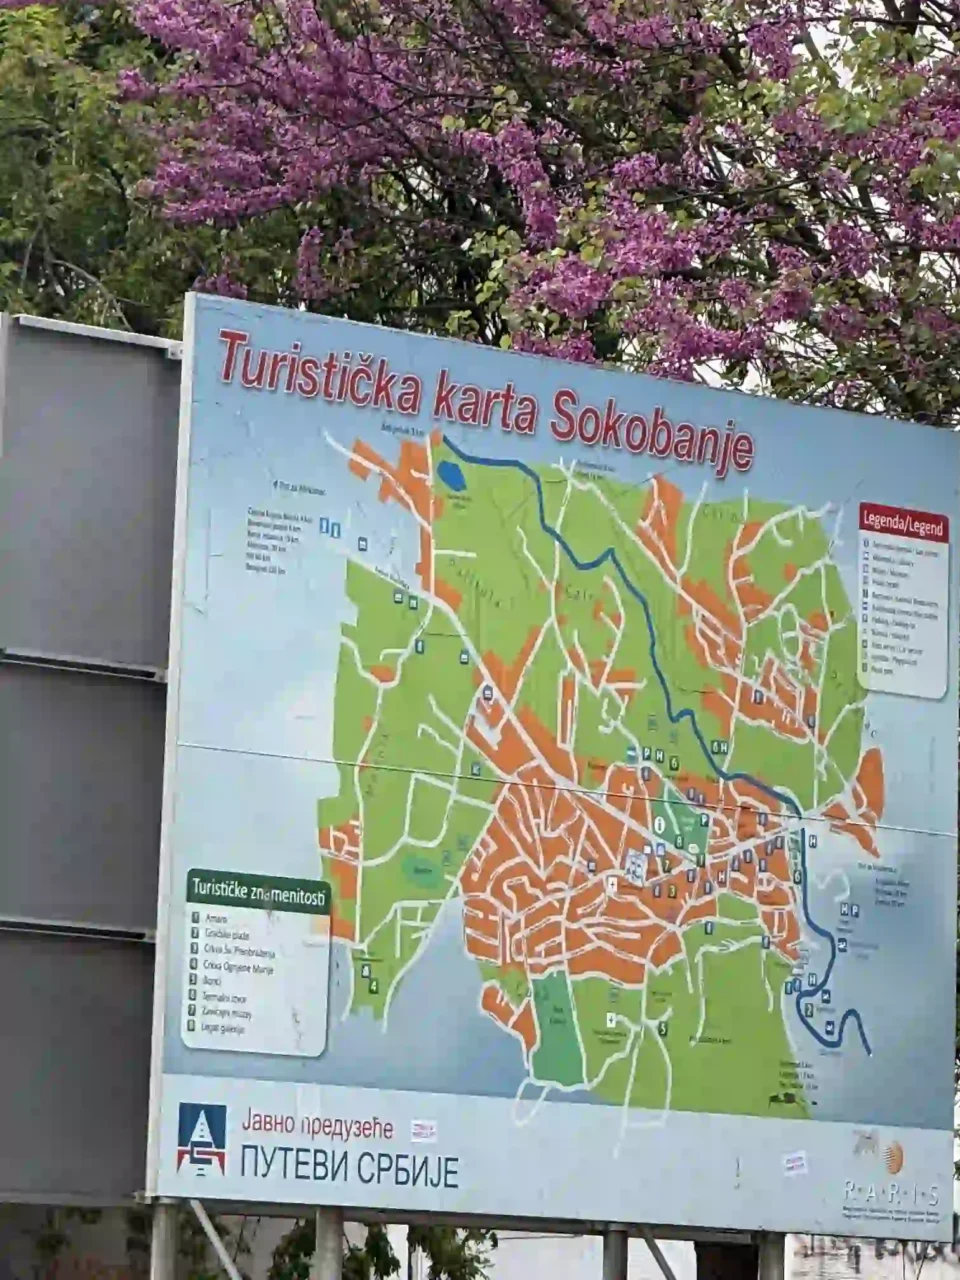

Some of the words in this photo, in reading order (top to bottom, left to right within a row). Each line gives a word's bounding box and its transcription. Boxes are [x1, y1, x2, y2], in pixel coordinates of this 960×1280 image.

[218, 328, 422, 415] Turistička
[434, 368, 538, 435] karta
[550, 387, 755, 479] Sokobanje
[863, 509, 944, 537] Legenda/Legend
[193, 877, 248, 899] Turističke
[251, 887, 326, 906] znamenitosti
[242, 1106, 295, 1133] Јавно
[301, 1115, 394, 1142] предузеће
[241, 1144, 348, 1182] ПУТЕВИ
[357, 1150, 460, 1188] СРБИЈЕ
